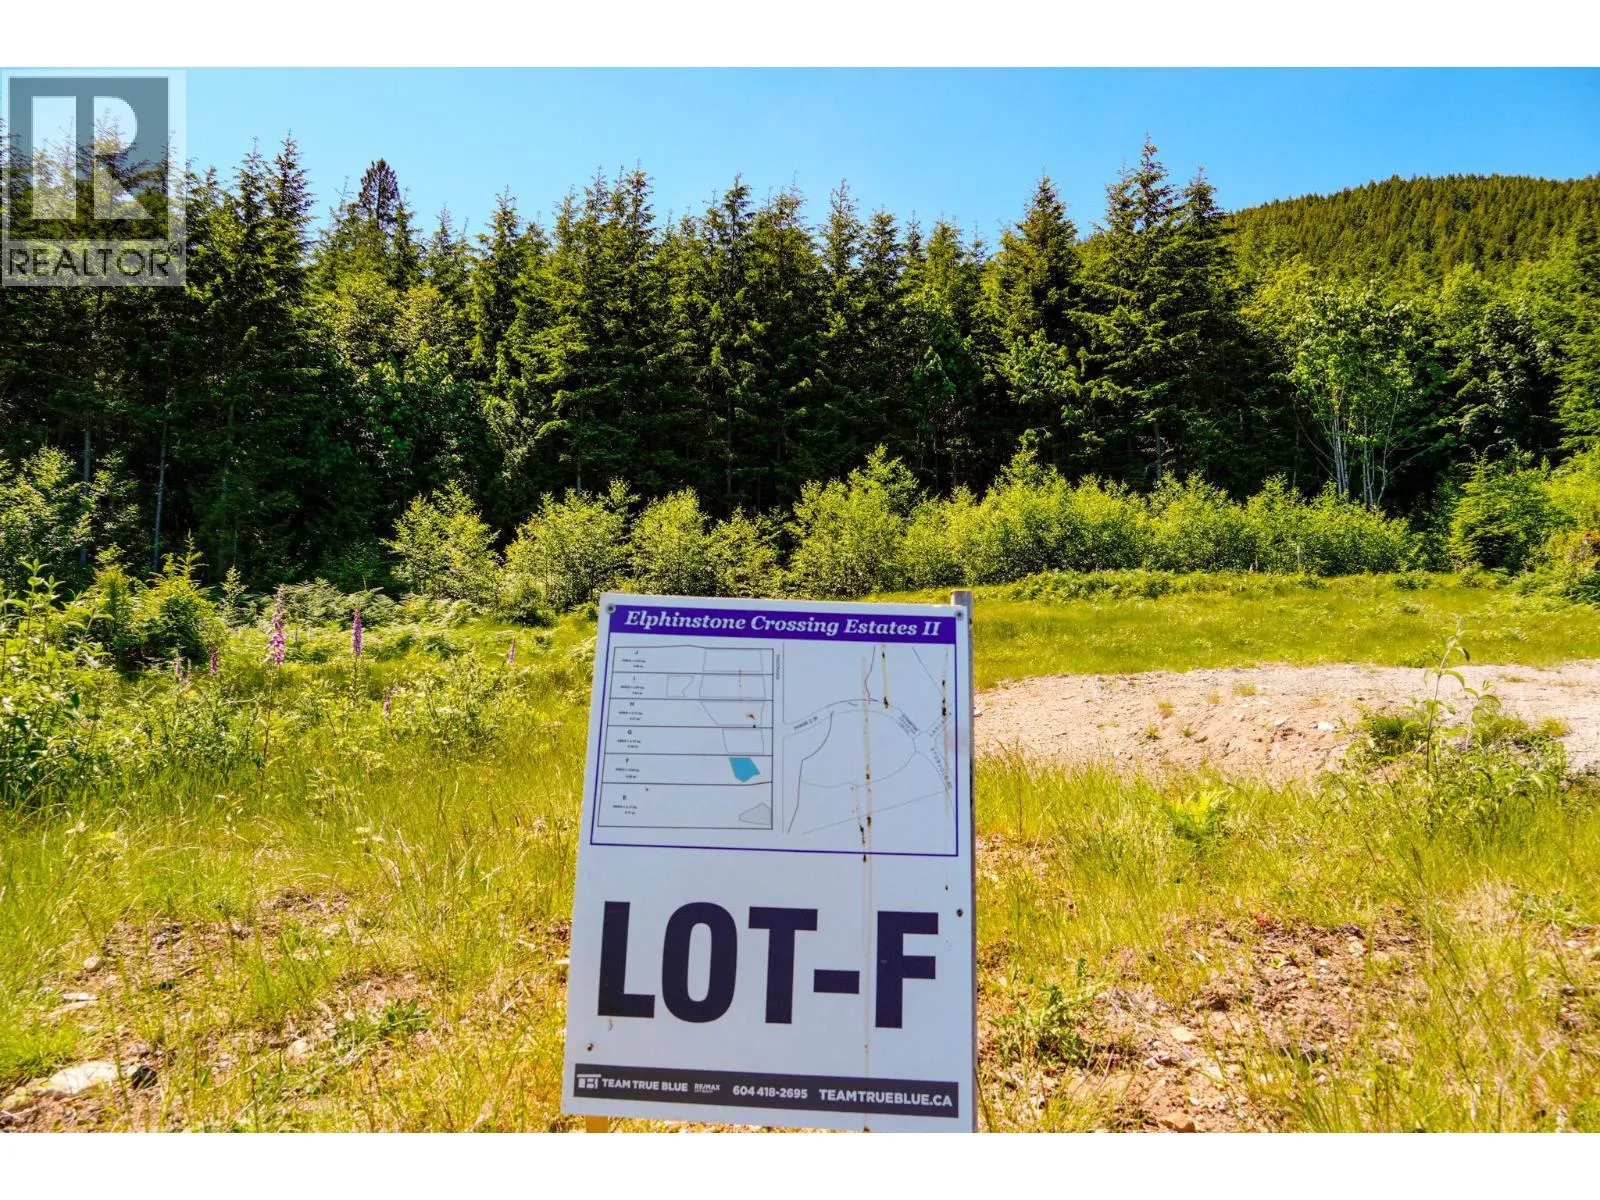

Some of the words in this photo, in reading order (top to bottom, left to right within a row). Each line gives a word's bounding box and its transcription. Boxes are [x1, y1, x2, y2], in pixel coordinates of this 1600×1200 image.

[624, 610, 746, 630] Elphinstone
[751, 615, 839, 636] Crossing
[843, 618, 918, 635] Estates
[921, 621, 941, 636] II
[598, 901, 939, 1029] LOT-F
[601, 1078, 631, 1089] TEAM
[632, 1080, 660, 1091] TRUE
[661, 1081, 688, 1092] BLUE
[732, 1085, 756, 1096] 604
[756, 1086, 808, 1099] 418-2695
[819, 1088, 953, 1107] TEAMTRUEBLUE.CA
